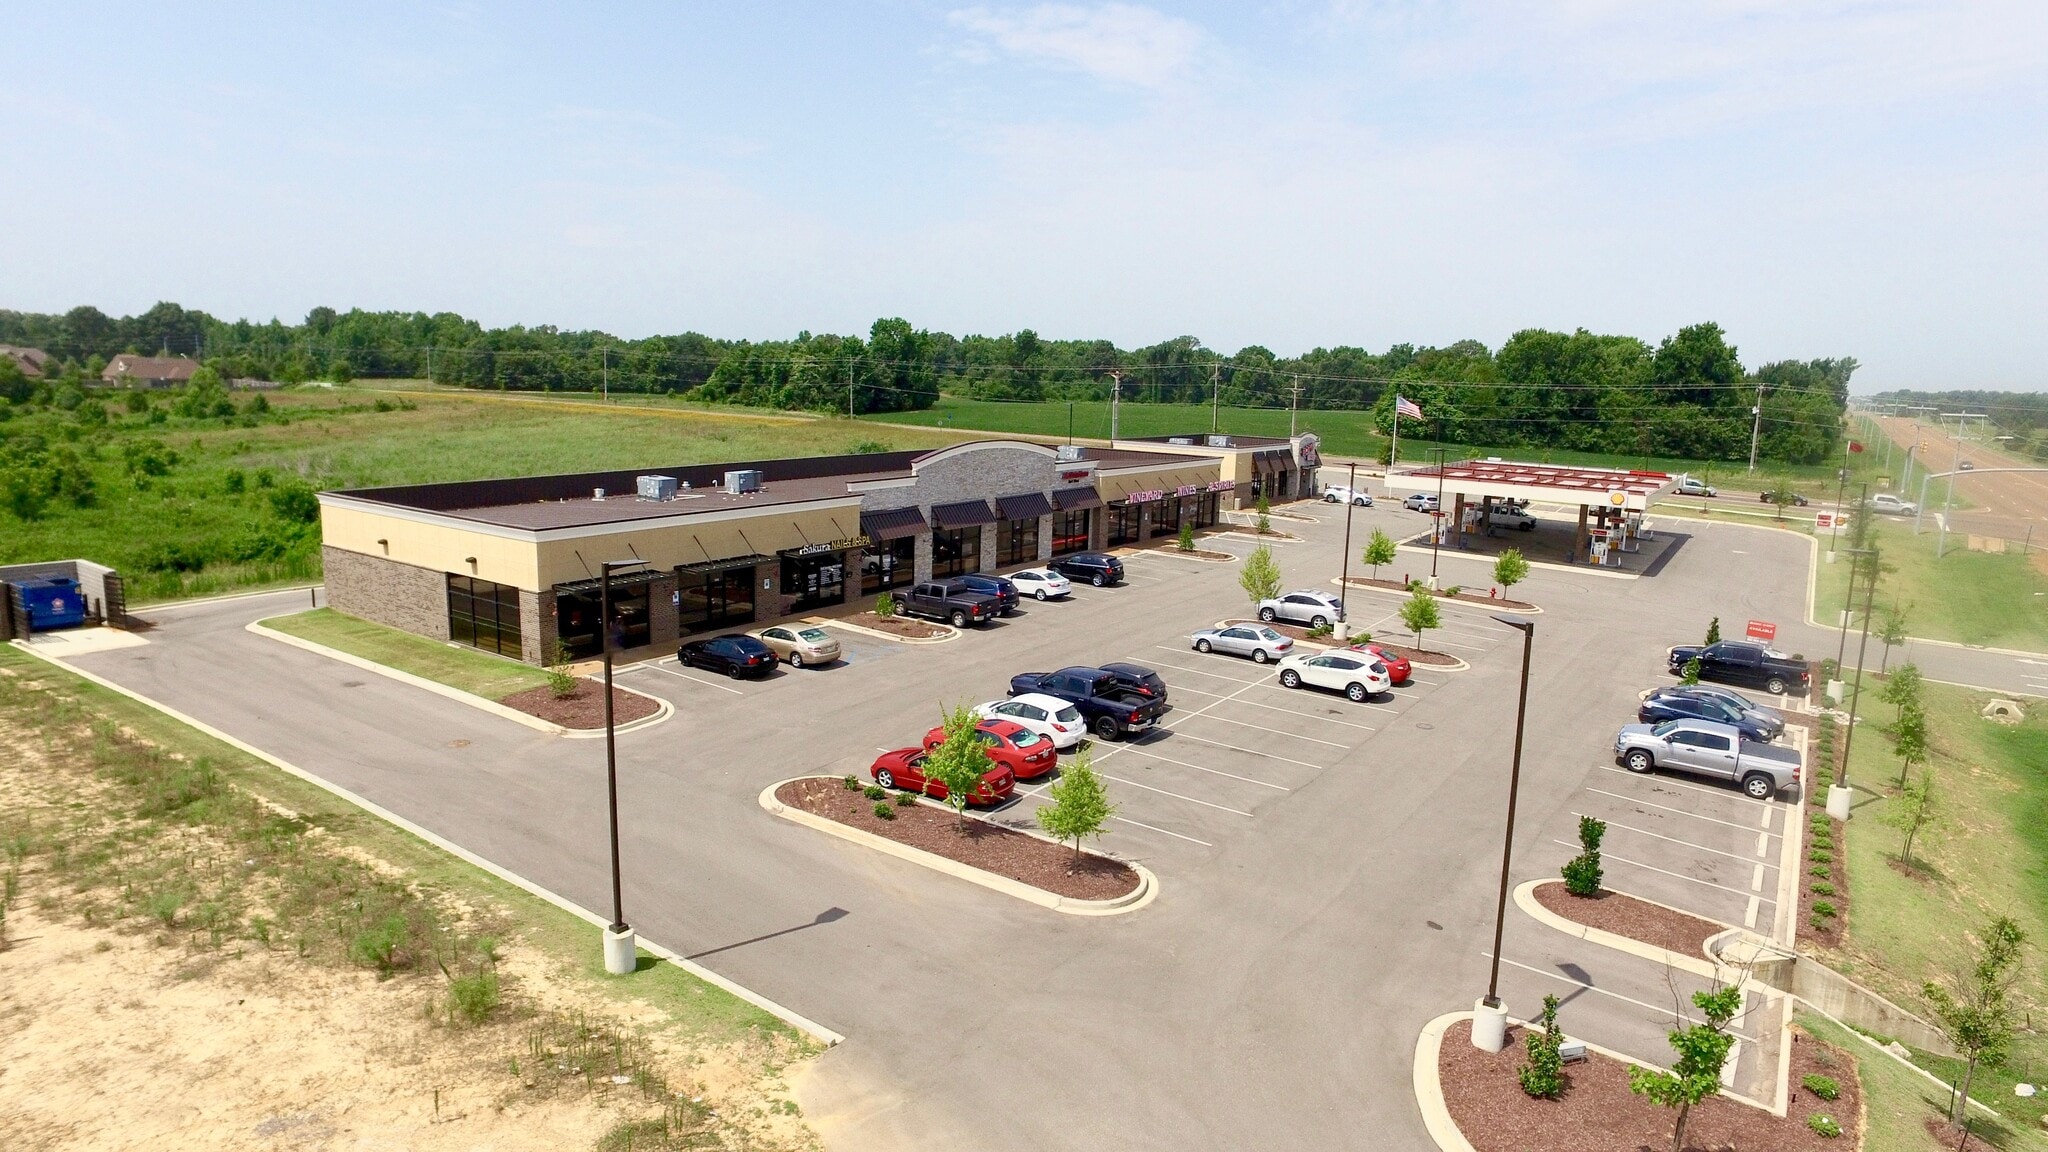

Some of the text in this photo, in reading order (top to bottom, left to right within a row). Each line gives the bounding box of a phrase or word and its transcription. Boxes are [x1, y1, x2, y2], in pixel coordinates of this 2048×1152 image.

[1128, 489, 1163, 504] VINEYARD
[1176, 484, 1197, 497] WINES
[803, 543, 831, 554] Sakura
[857, 536, 870, 545] SPA
